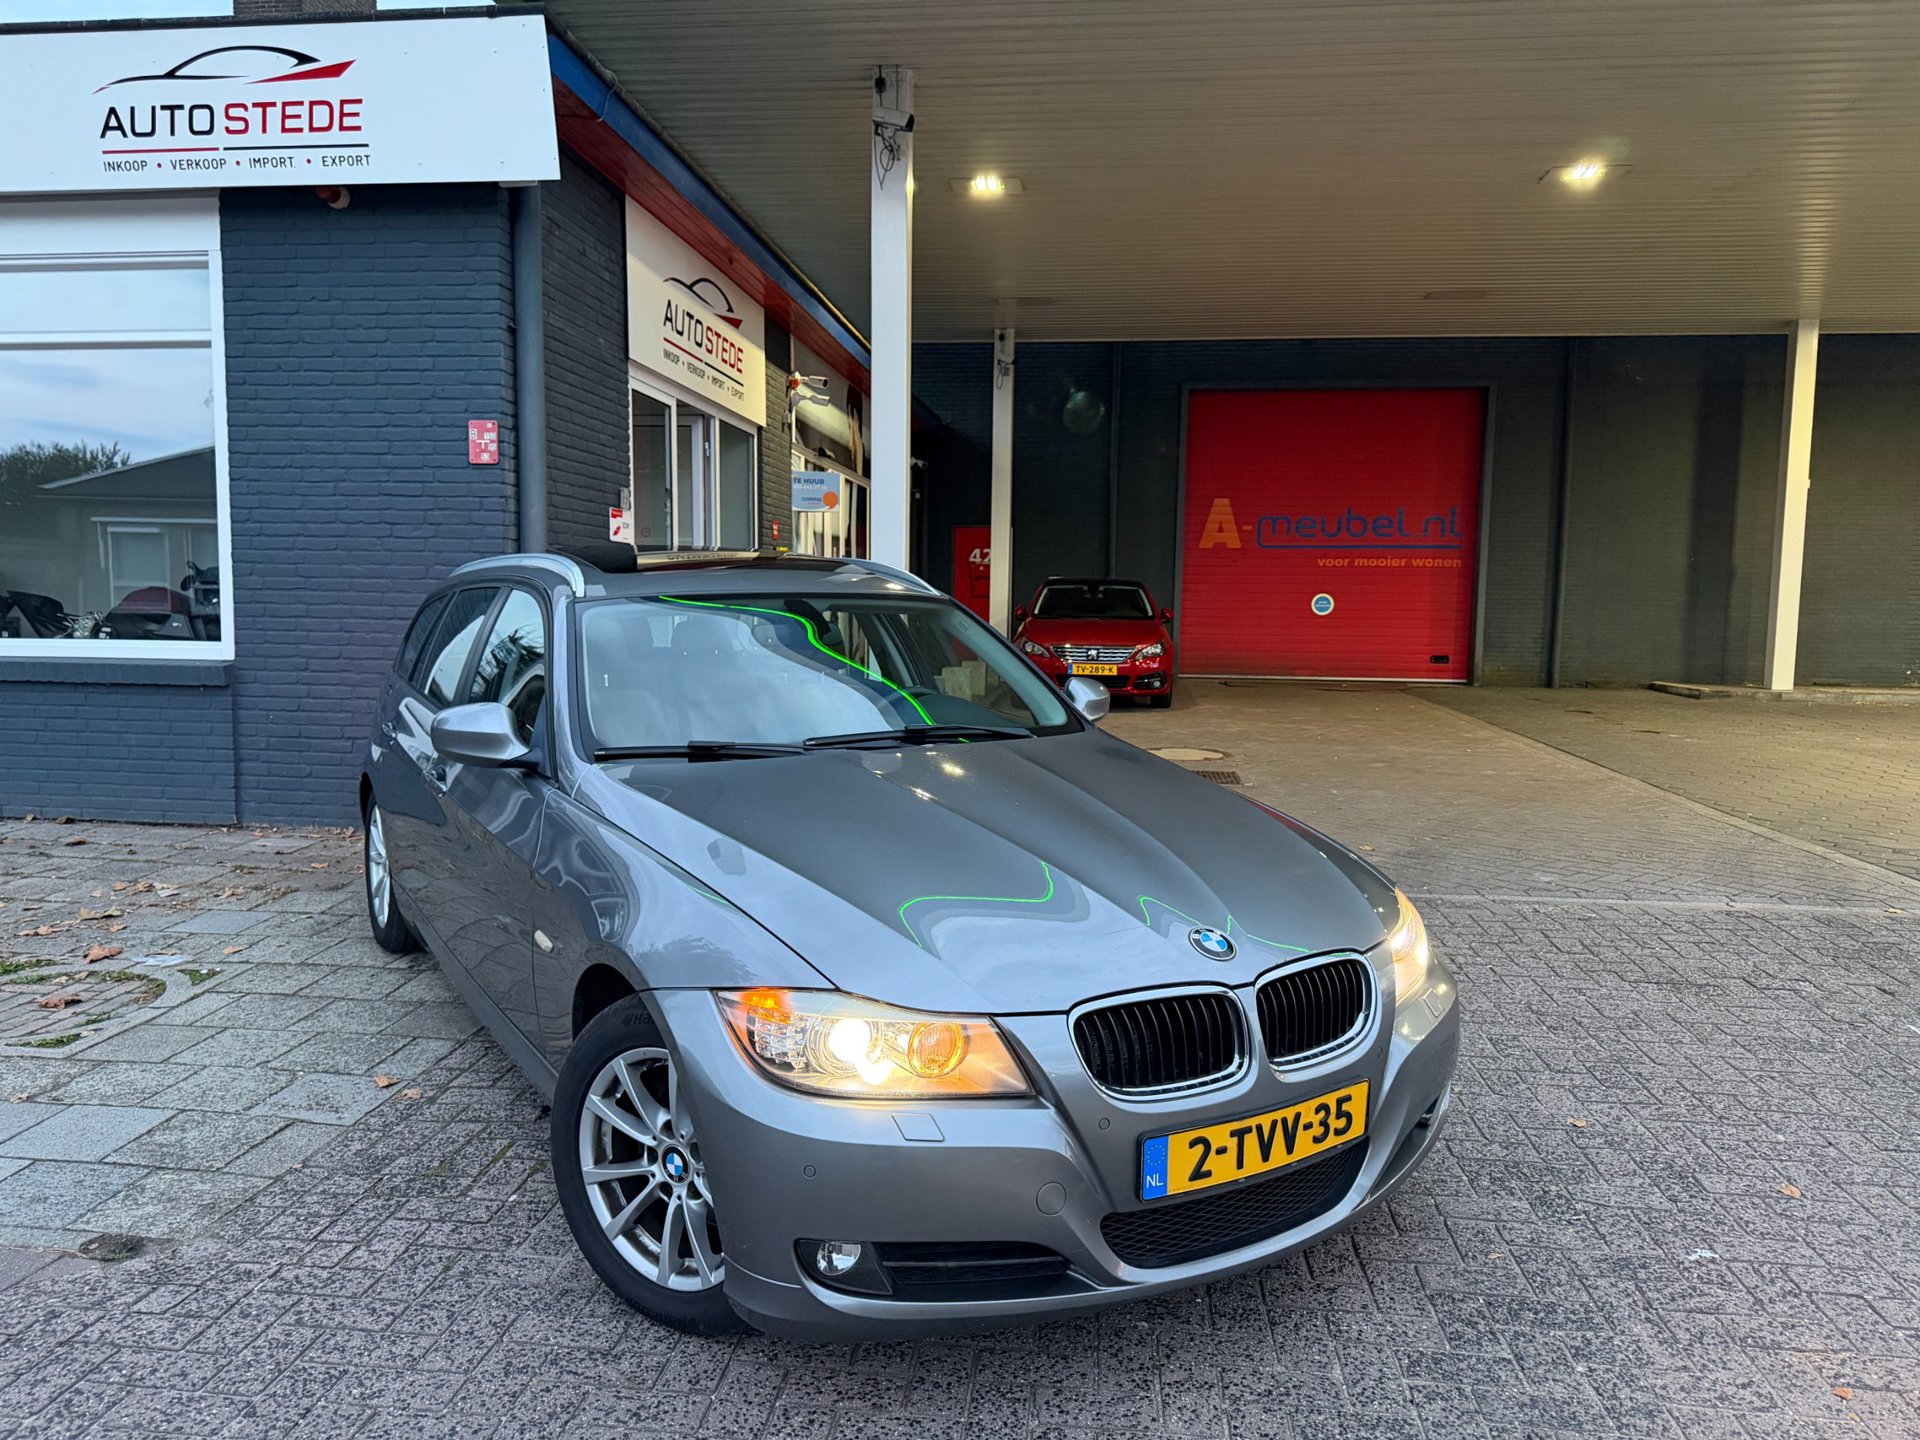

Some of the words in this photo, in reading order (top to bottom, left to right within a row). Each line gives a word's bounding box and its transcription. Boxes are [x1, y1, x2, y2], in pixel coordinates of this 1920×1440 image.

[103, 159, 148, 172] INKOOP
[169, 158, 227, 171] VERKOOP
[248, 156, 295, 169] IMPORT
[321, 154, 371, 168] EXPORT
[663, 347, 680, 365] INKOOP
[687, 361, 706, 380] VERKOOP
[803, 477, 825, 485] HUUR
[1199, 498, 1464, 549] A-meubel.nl
[1317, 557, 1351, 567] voor
[1354, 556, 1407, 567] mooier
[1411, 557, 1462, 568] wonen
[1075, 665, 1114, 674] TV-289-K
[1188, 1094, 1353, 1183] 2-TVV-35
[1146, 1175, 1164, 1189] NL
